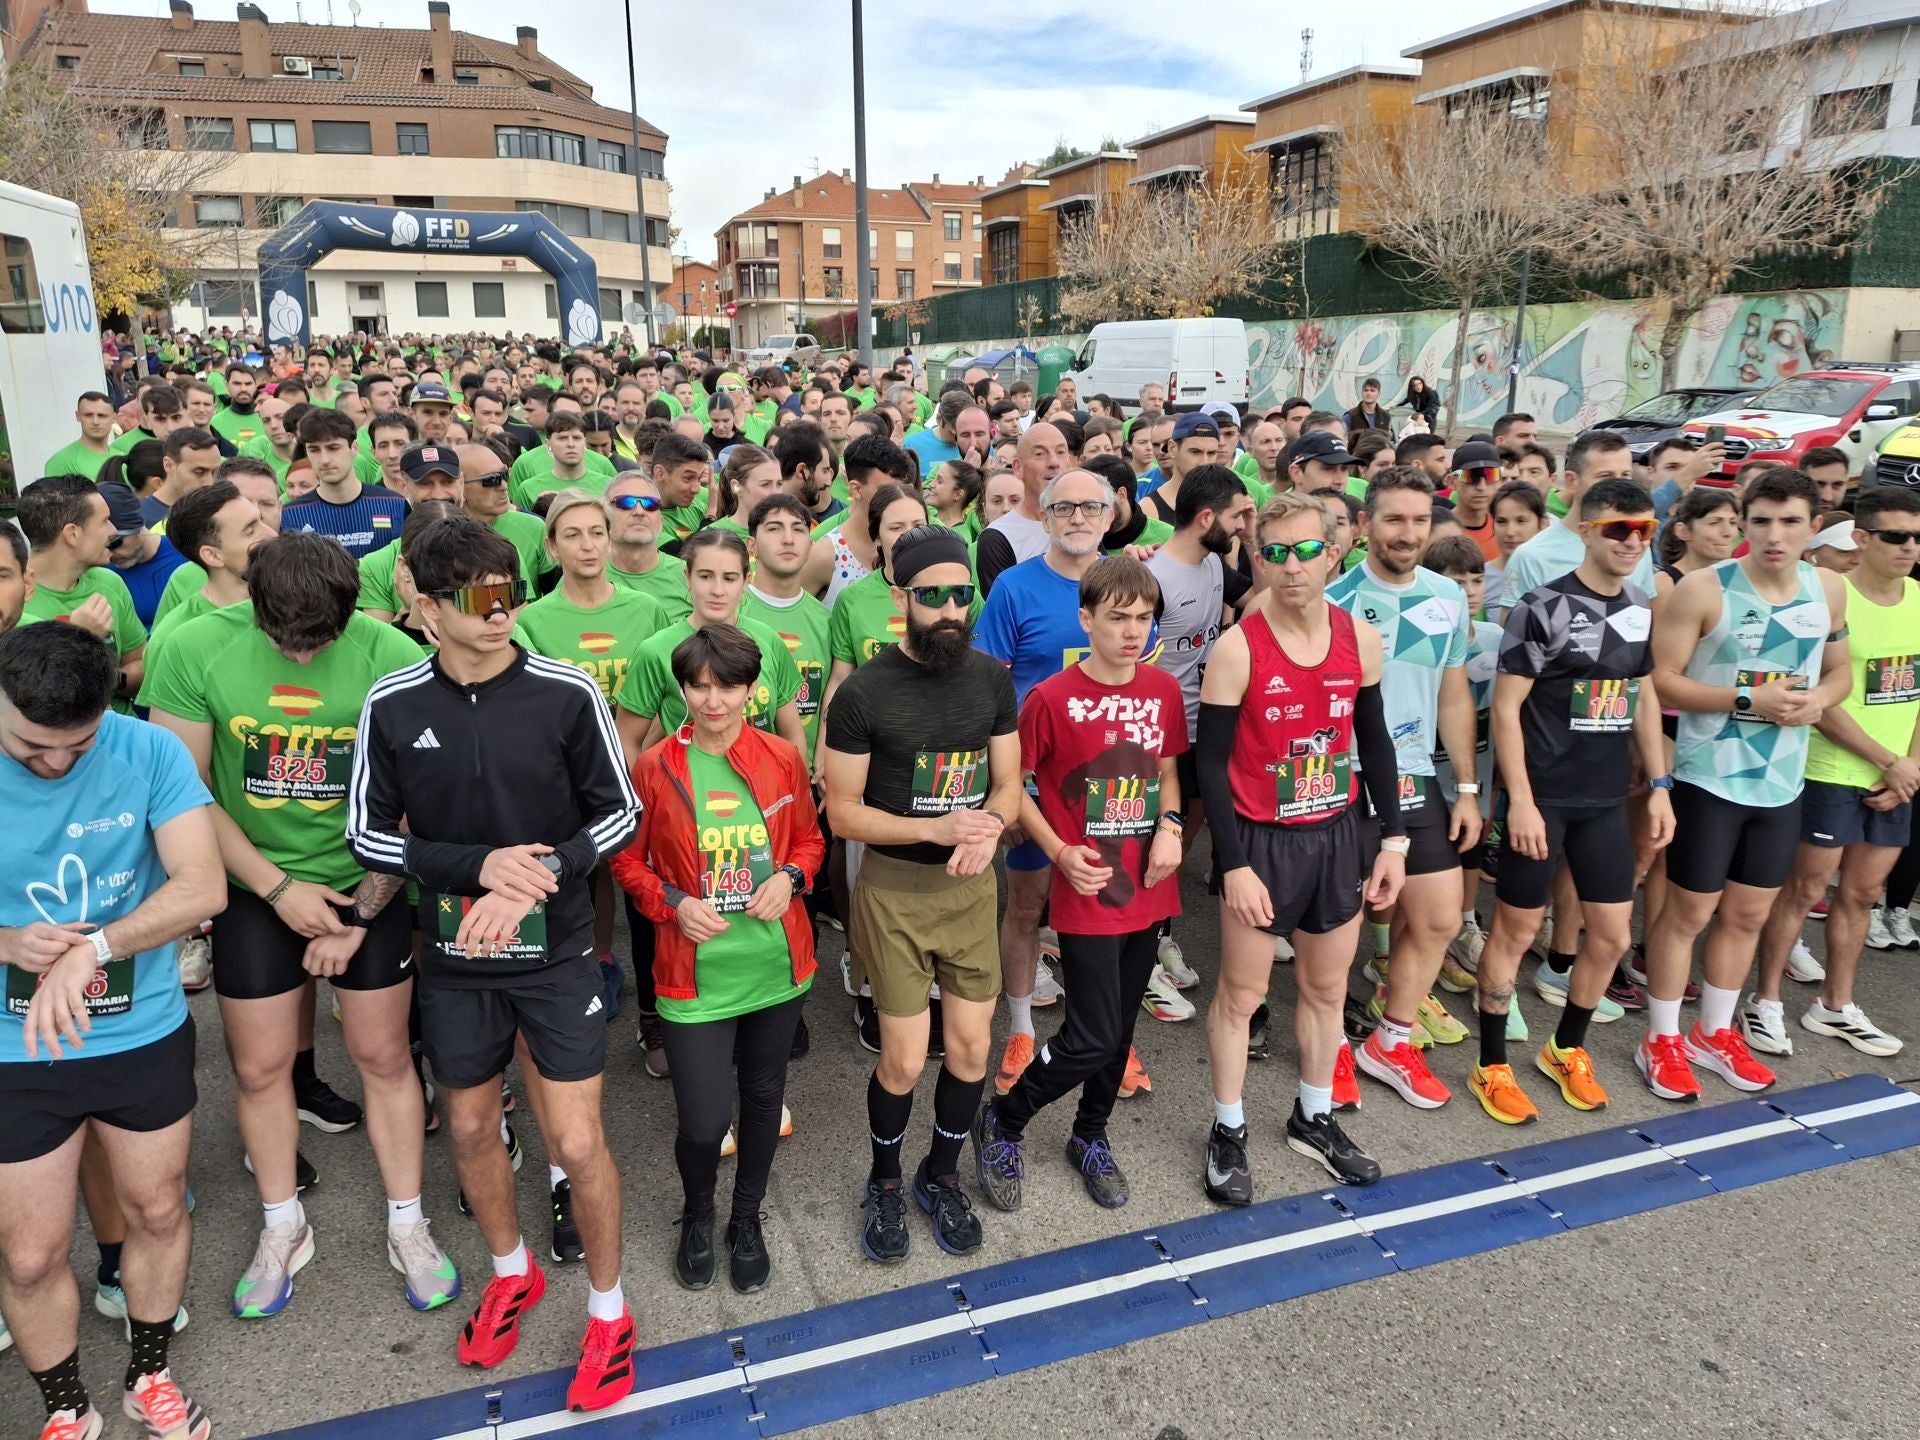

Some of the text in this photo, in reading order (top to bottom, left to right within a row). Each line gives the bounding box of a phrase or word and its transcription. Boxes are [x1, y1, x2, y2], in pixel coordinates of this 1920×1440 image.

[425, 217, 470, 238] FFD
[1067, 695, 1161, 722] キングコング
[1589, 697, 1628, 719] 110
[268, 755, 327, 783] 325
[251, 779, 346, 791] CARRERA SOLIDARIA
[251, 787, 289, 797] GUARDIA
[291, 790, 314, 798] CIVIL
[949, 772, 964, 796] 3
[1295, 773, 1335, 801] 269
[918, 796, 951, 804] CARRERA
[1105, 798, 1145, 821] 390
[1283, 801, 1312, 811] CARRERA
[1121, 820, 1154, 829] SOLIDARIA
[697, 824, 767, 850] orre
[701, 868, 753, 897] 148
[724, 904, 744, 912] CIVIL
[85, 995, 129, 1007] LIDARIA
[983, 1275, 1028, 1292] Feibot
[1124, 1290, 1168, 1310] Feibot
[766, 1326, 814, 1346] Feibot
[910, 1345, 959, 1367] Feibot
[670, 1405, 724, 1427] Feibot
